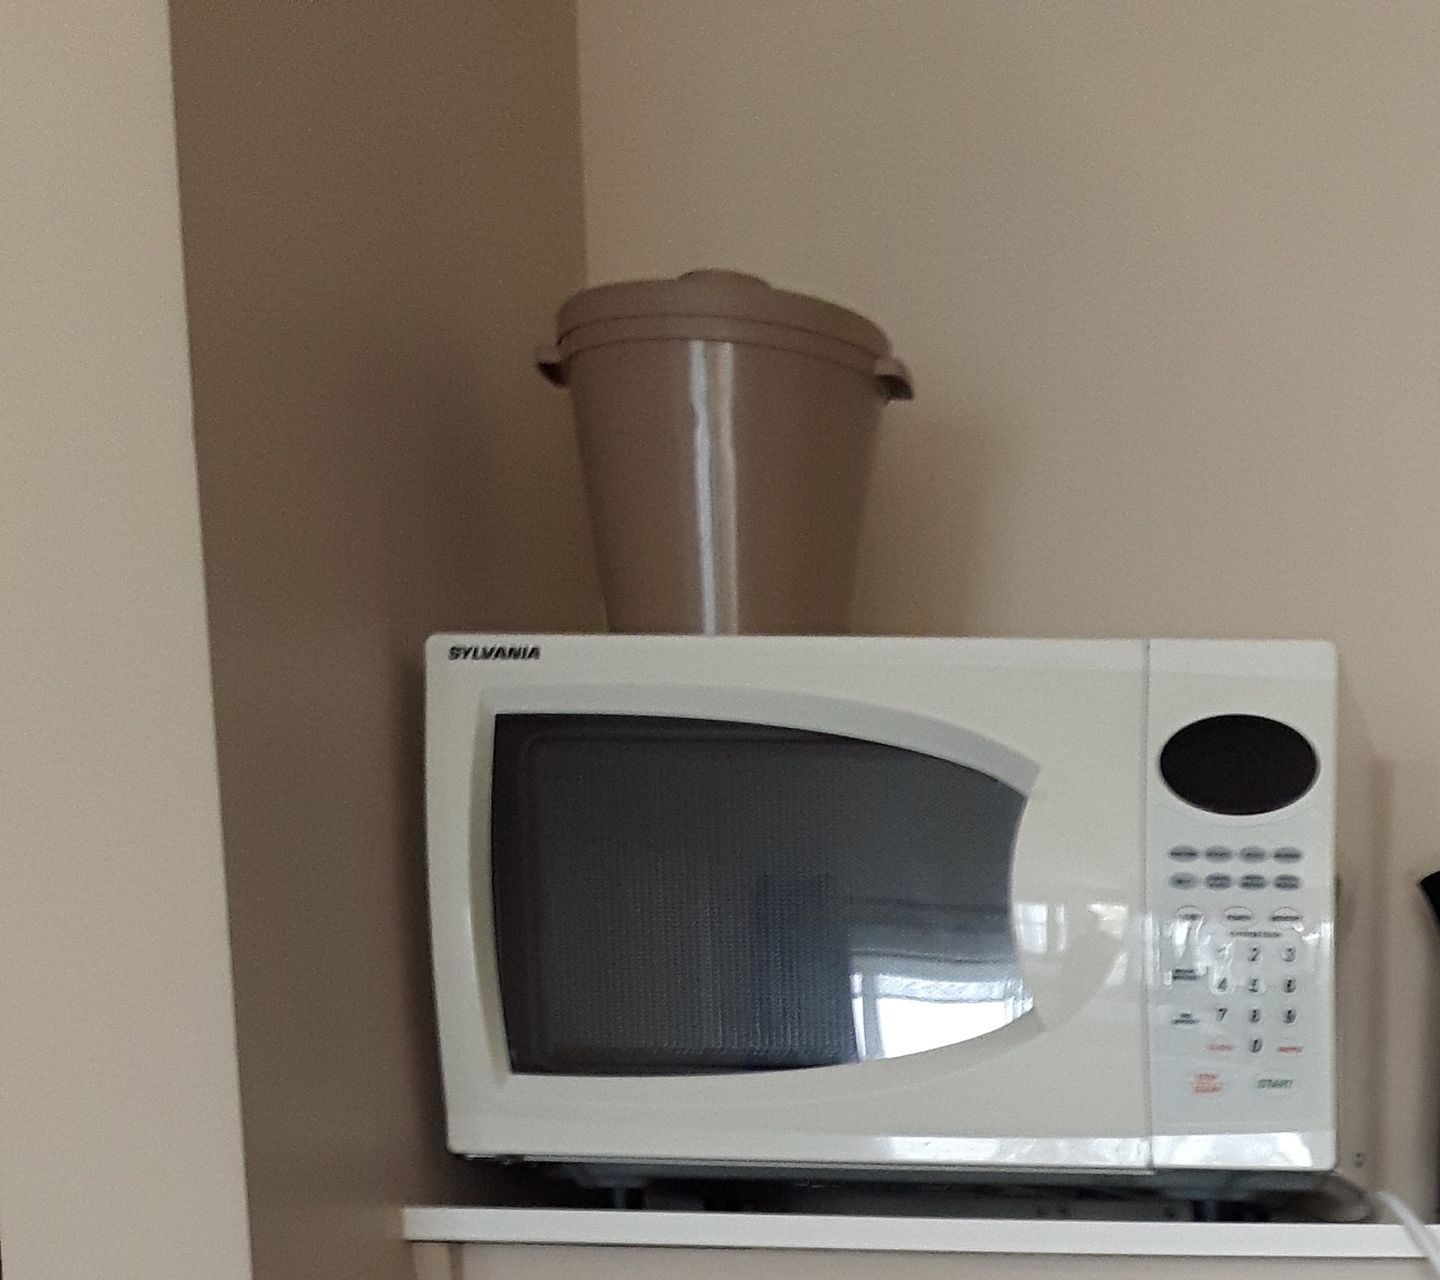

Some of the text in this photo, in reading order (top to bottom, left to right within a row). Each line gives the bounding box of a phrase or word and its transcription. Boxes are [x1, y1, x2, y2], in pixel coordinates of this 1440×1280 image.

[448, 646, 540, 660] SYLVANIA
[1248, 946, 1260, 962] 2
[1217, 977, 1228, 992] 4
[1216, 1007, 1228, 1022] 7
